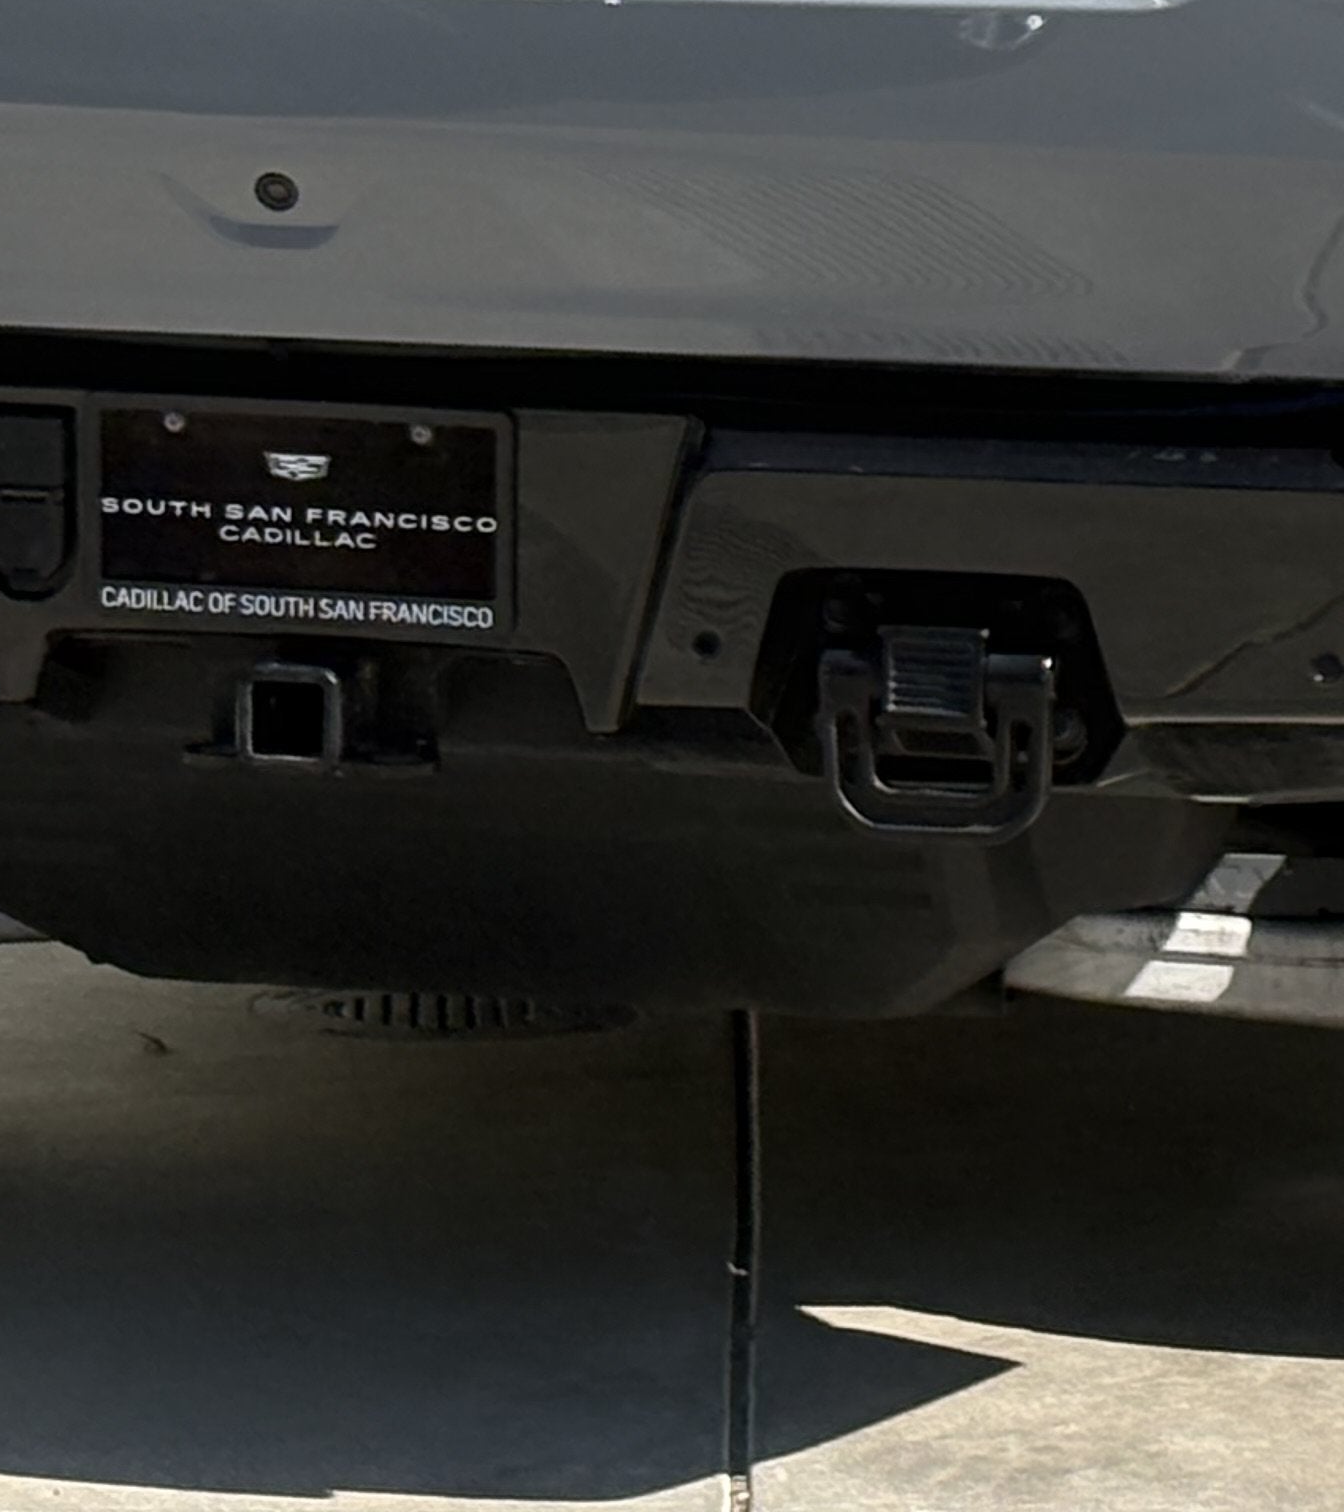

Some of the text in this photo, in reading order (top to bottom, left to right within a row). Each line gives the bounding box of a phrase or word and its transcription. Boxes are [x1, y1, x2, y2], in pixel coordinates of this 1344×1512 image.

[100, 496, 498, 534] SOUTH SAN FRANCISCO
[218, 524, 377, 550] CADILLAC
[100, 585, 494, 629] CADILLAC OF SOUTH SAN FRANCISCO
